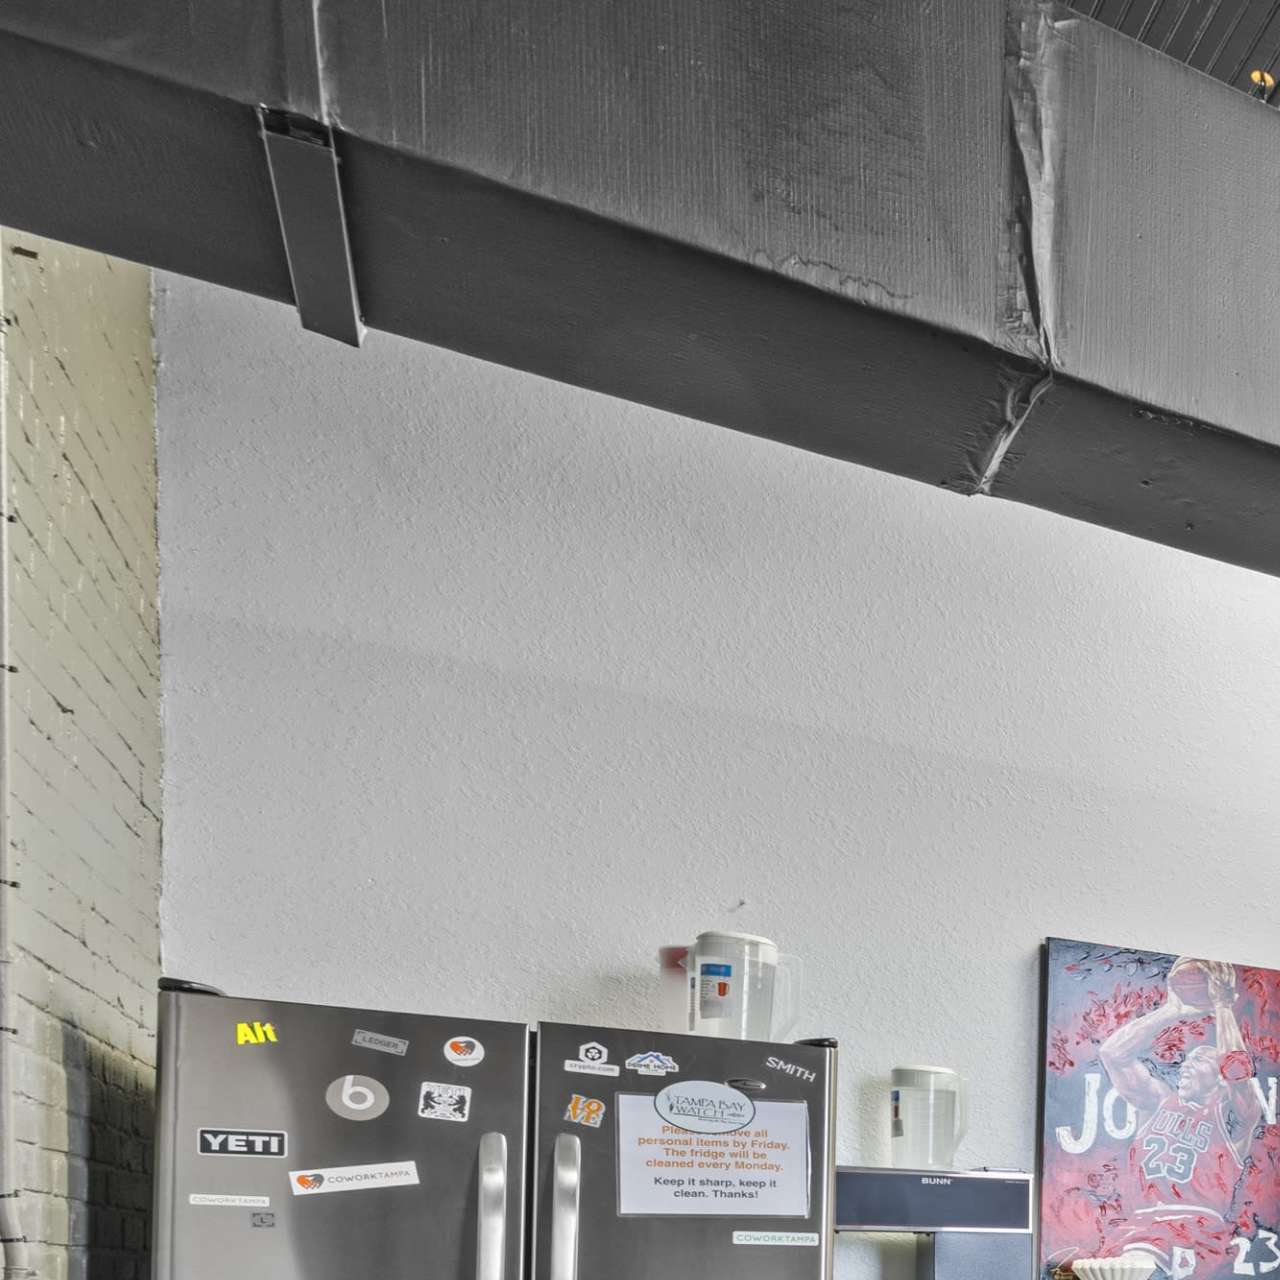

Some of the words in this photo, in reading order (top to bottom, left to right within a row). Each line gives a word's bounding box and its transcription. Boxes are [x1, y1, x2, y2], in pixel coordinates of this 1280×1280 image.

[236, 1021, 278, 1045] Alt
[361, 1035, 399, 1050] LEDGER
[569, 1063, 616, 1073] crypto.com
[766, 1057, 816, 1082] SMITH
[1056, 1073, 1278, 1154] JON
[662, 1125, 696, 1135] Plea
[754, 1130, 768, 1138] all
[203, 1133, 281, 1152] YETI
[638, 1137, 692, 1146] personal
[696, 1138, 730, 1147] items
[733, 1139, 747, 1149] by
[751, 1140, 790, 1151] Friday.
[664, 1148, 687, 1157] The
[690, 1149, 726, 1160] fridge
[729, 1150, 749, 1159] will
[753, 1151, 767, 1160] be
[1141, 1135, 1197, 1184] 23
[646, 1159, 694, 1168] cleaned
[698, 1162, 731, 1171] every
[735, 1161, 784, 1173] Monday.
[327, 1170, 410, 1184] COWORKTAMPA
[654, 1177, 685, 1187] Keep
[688, 1178, 695, 1186] it
[739, 1179, 767, 1189] keep
[769, 1180, 776, 1188] it
[921, 1177, 951, 1185] BUNN
[674, 1189, 709, 1198] clean.
[712, 1190, 758, 1199] Thanks!
[736, 1233, 816, 1243] COWORKTAMPA
